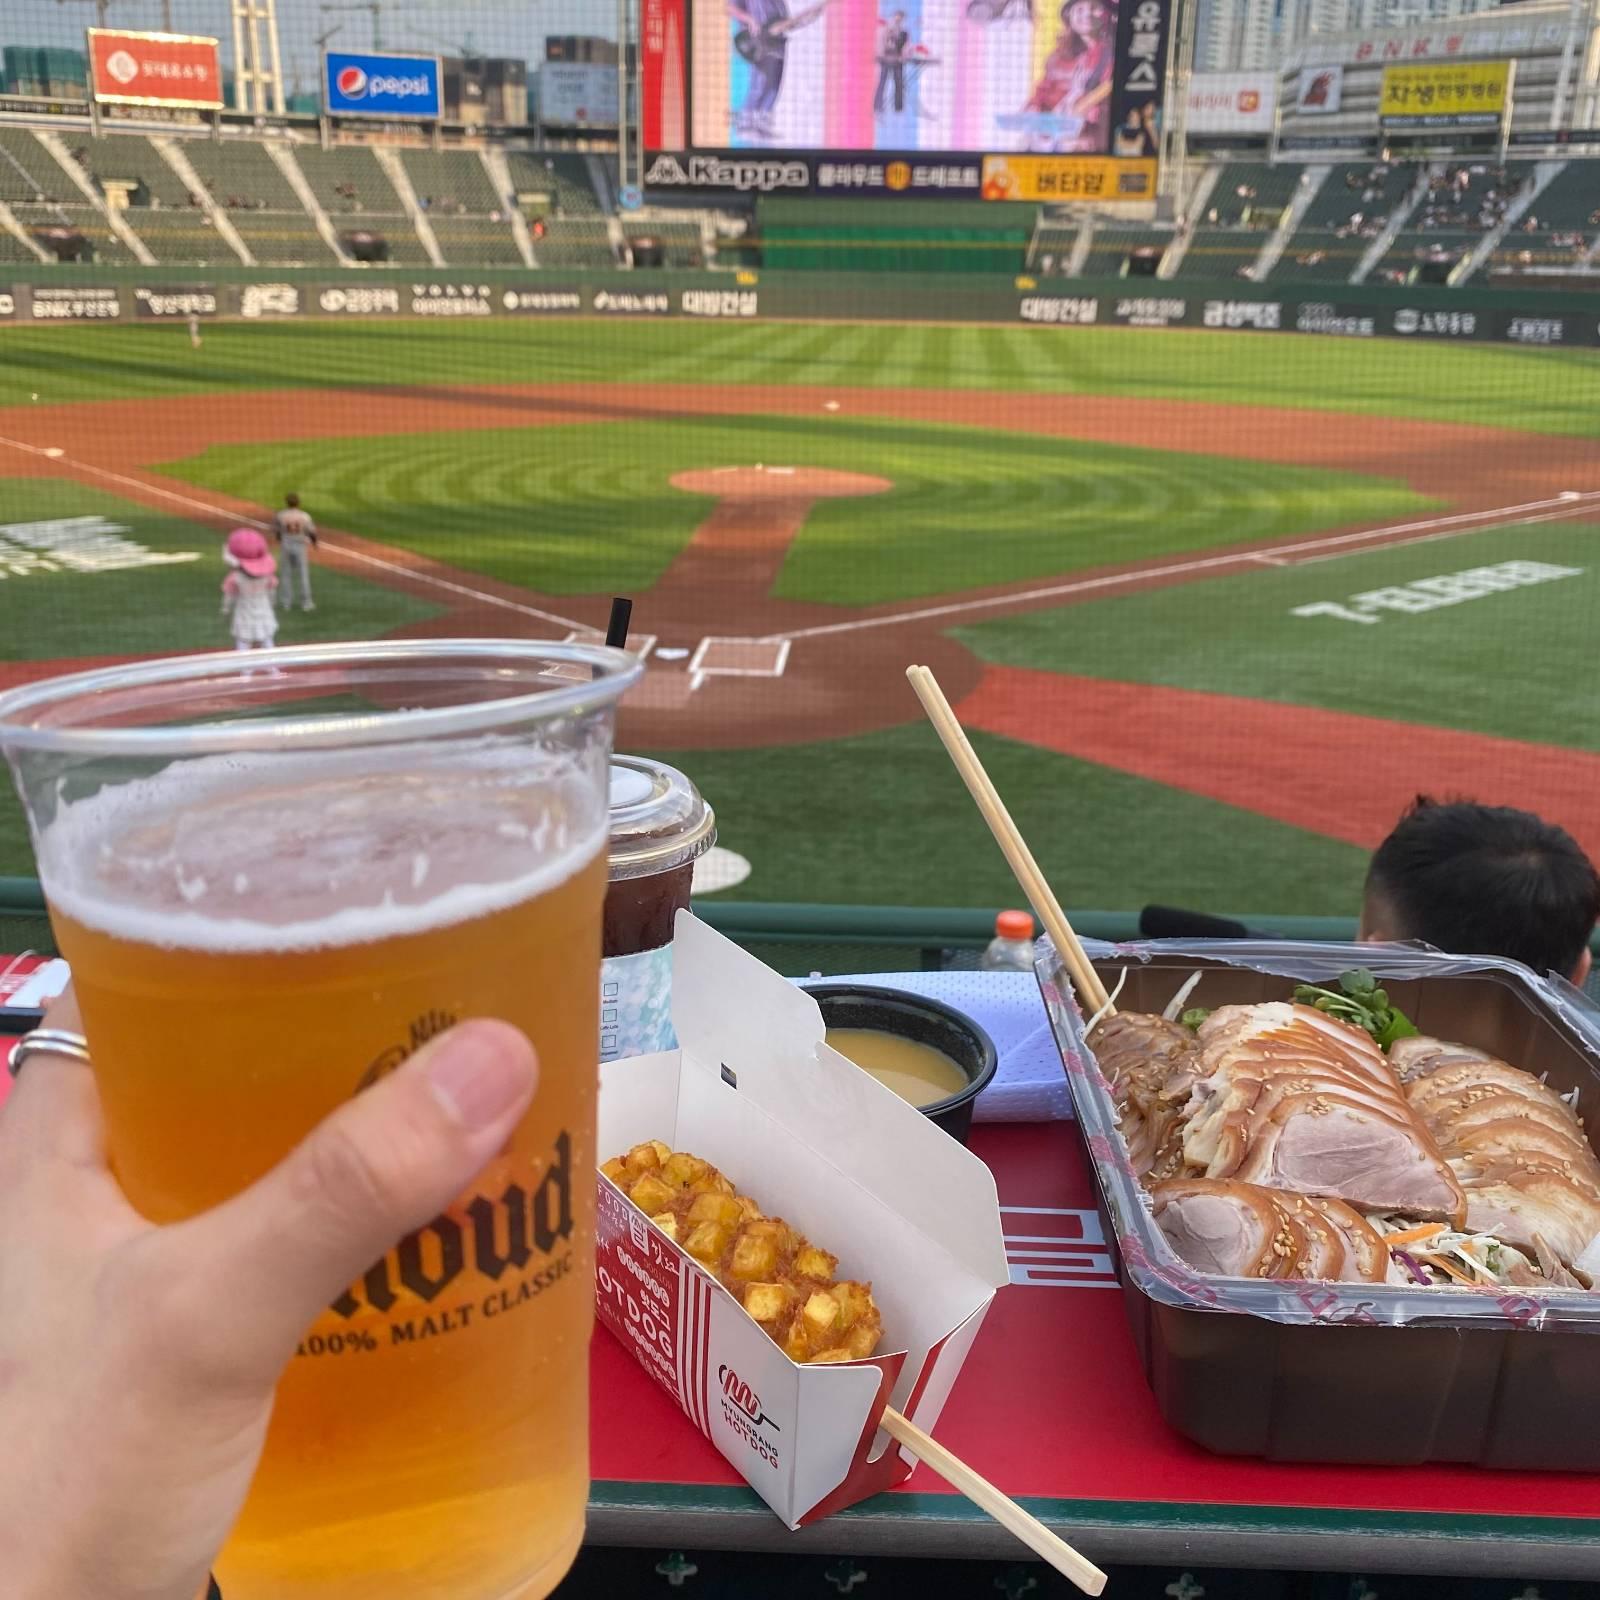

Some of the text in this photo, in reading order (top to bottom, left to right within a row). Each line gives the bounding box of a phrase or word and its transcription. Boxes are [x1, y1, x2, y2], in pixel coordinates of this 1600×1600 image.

[369, 74, 430, 99] pepsi
[688, 155, 810, 191] Kappa
[390, 1303, 475, 1347] MALT
[481, 1250, 574, 1319] CLASSIC
[720, 1398, 779, 1457] MYUNGRANG
[724, 1410, 779, 1470] HOTDOG
